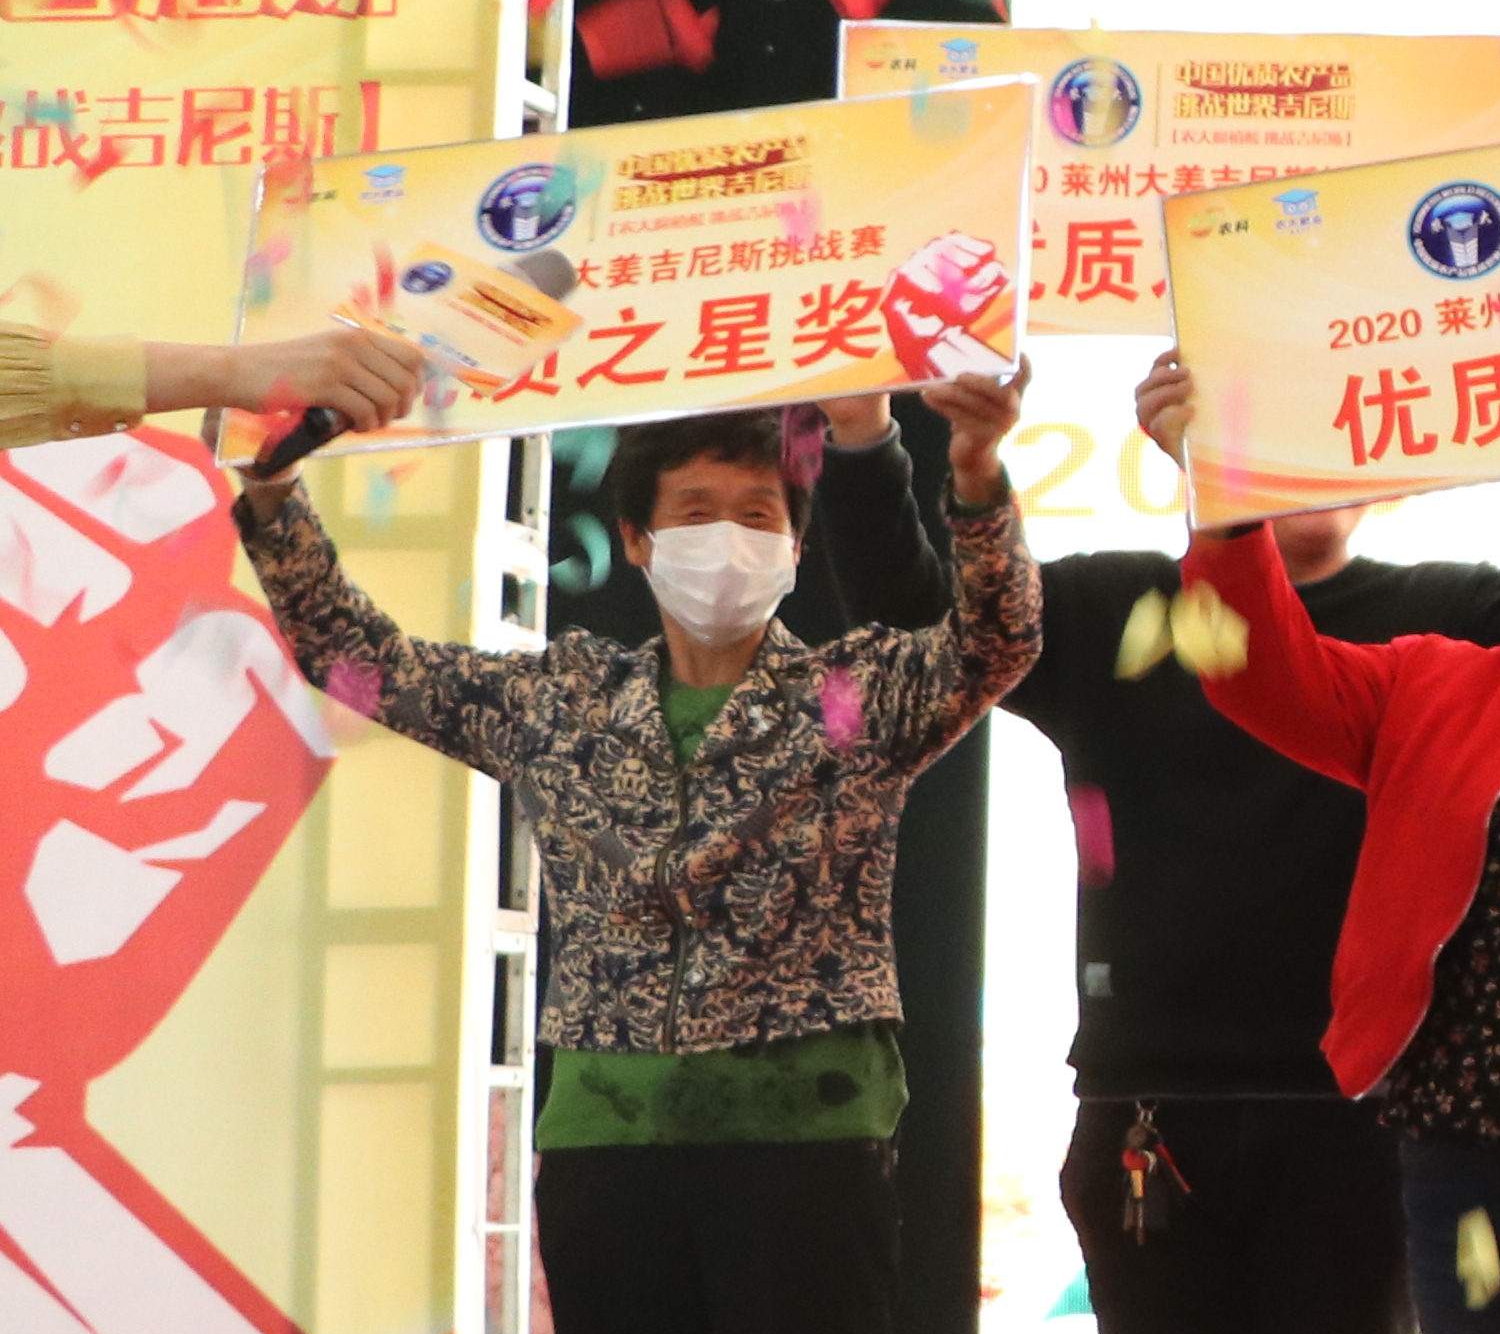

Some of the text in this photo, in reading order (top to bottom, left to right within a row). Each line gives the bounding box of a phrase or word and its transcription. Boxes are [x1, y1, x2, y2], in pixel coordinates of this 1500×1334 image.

[0, 81, 382, 167] 战吉尼斯】
[1328, 308, 1423, 350] 2020
